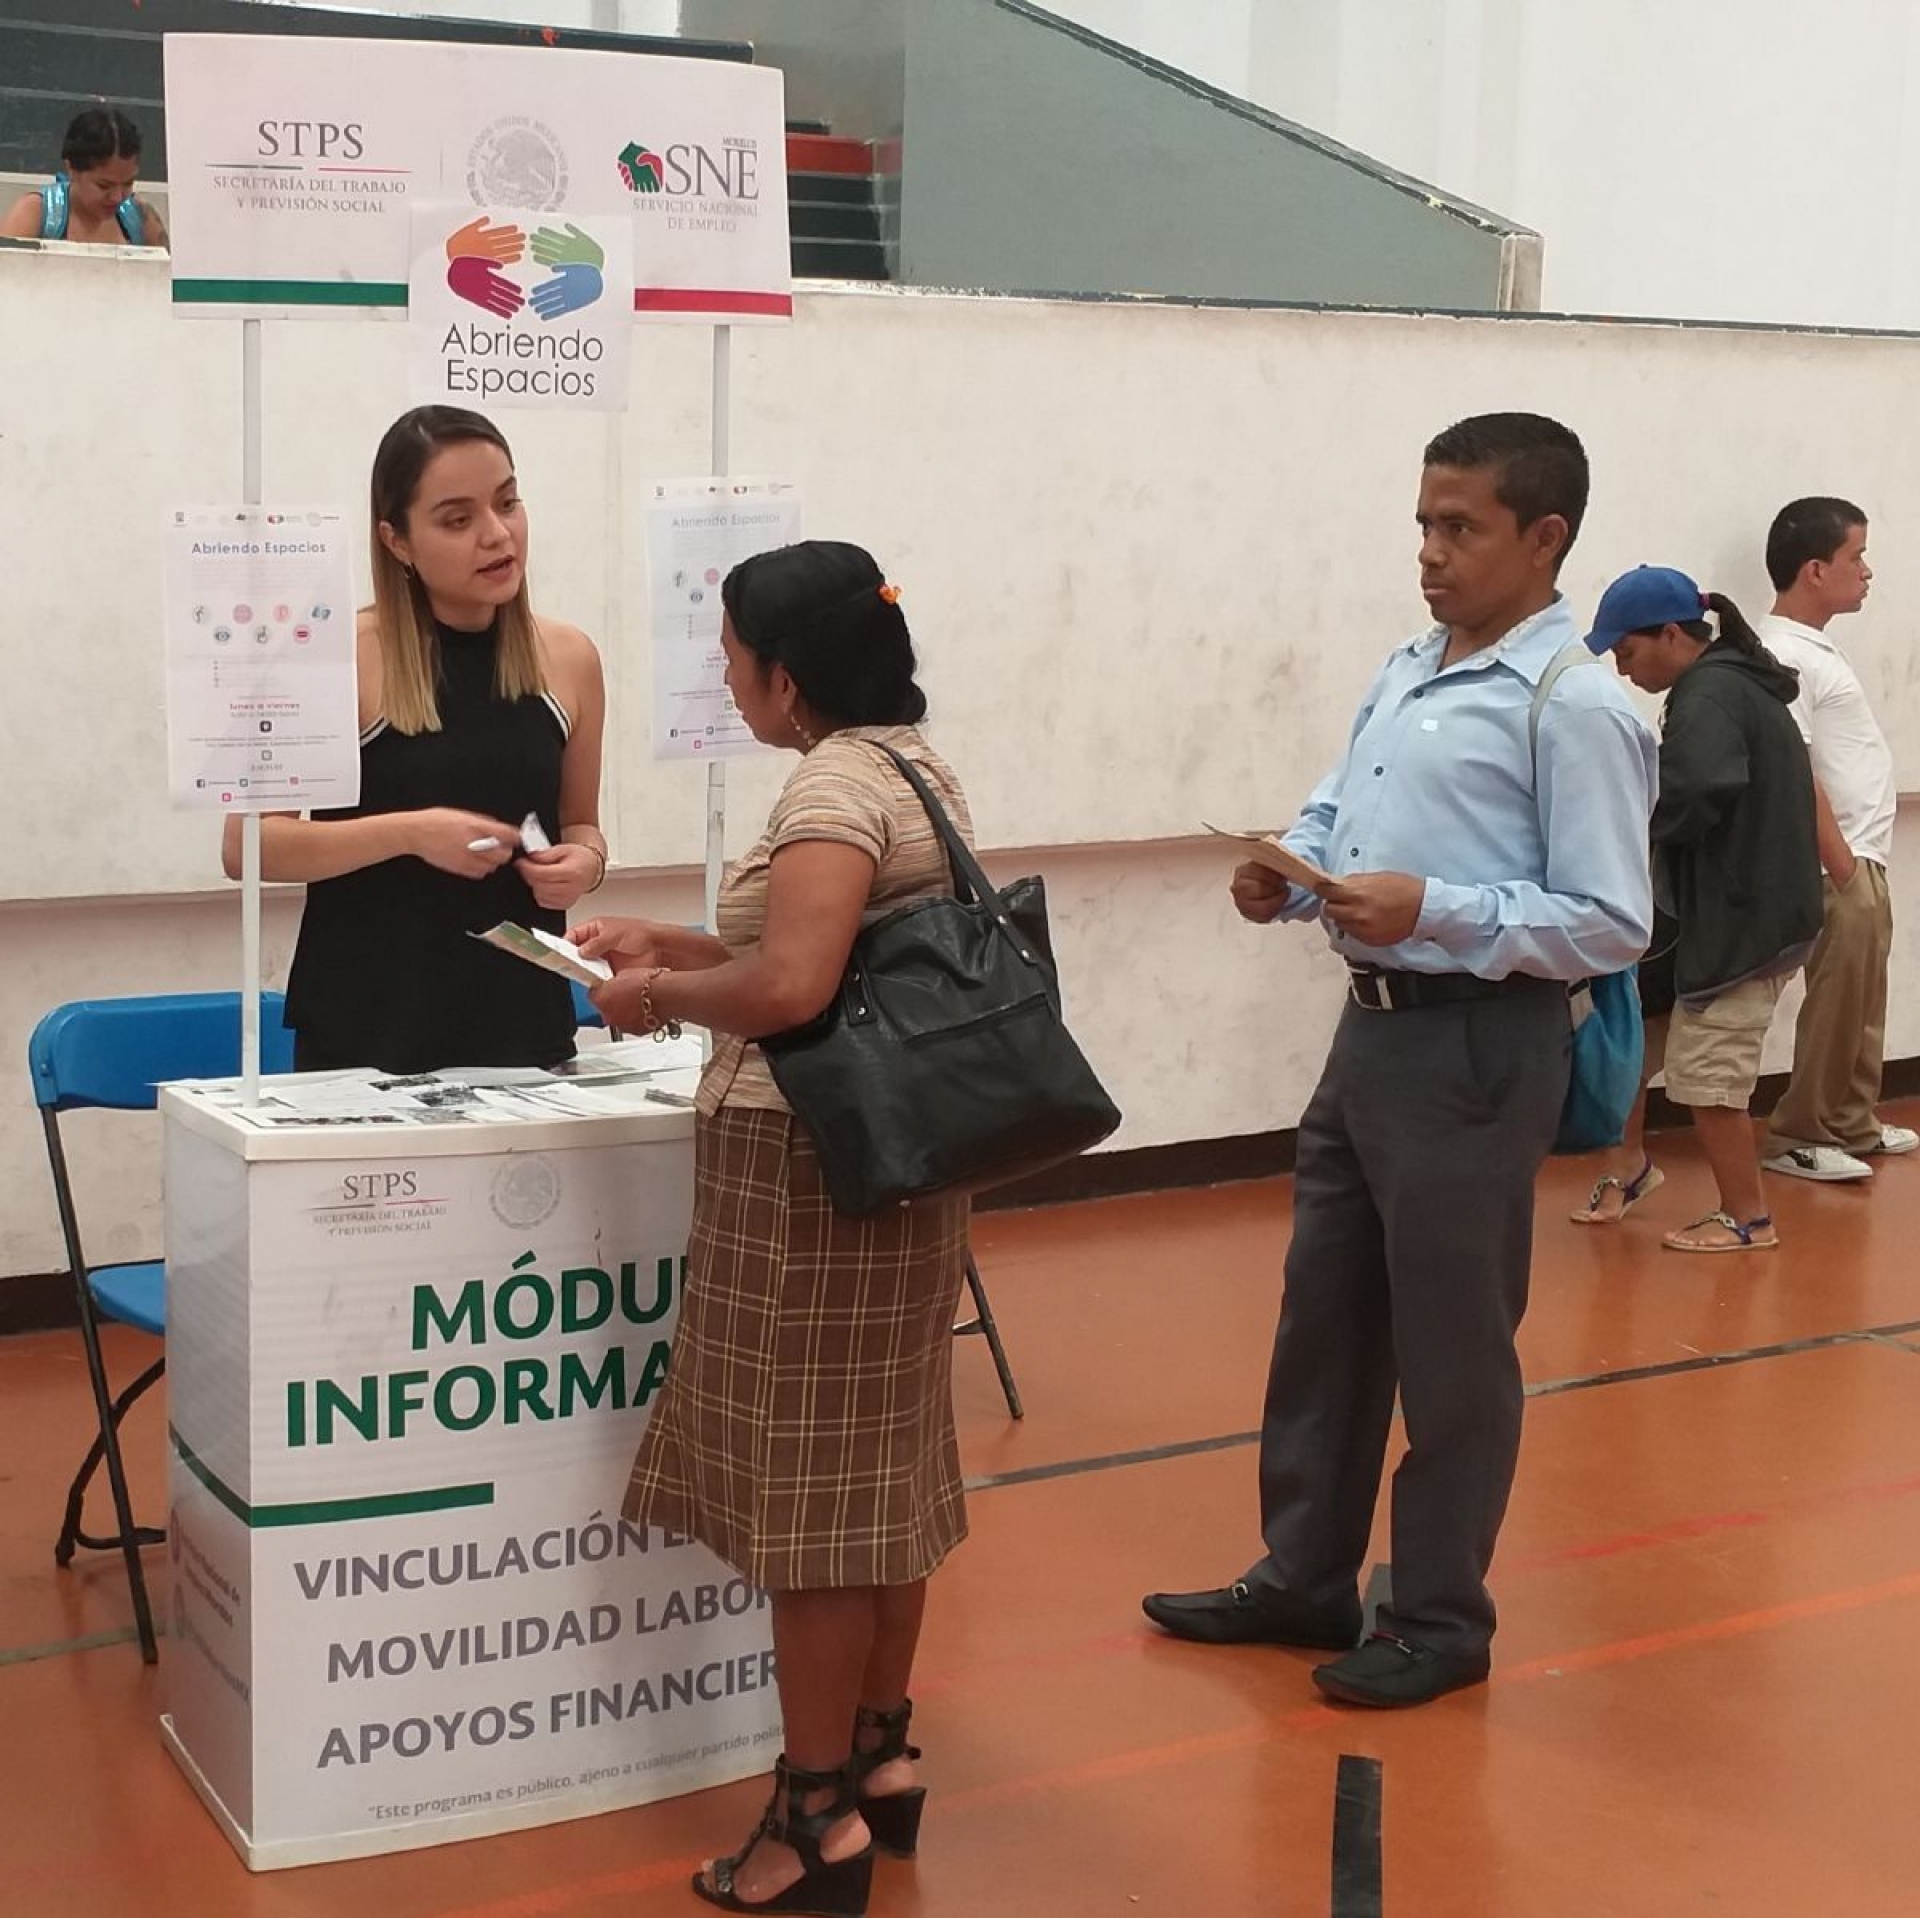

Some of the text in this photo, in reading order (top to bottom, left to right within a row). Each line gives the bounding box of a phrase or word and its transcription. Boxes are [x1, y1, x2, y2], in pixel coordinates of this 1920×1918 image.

[258, 120, 364, 160] STPS
[213, 176, 406, 194] SECRETARÍA DEL TRABAJO
[665, 144, 758, 200] SNE
[250, 196, 329, 212] PREVISIÓN
[332, 200, 384, 213] SOCIAL
[633, 199, 757, 217] SERVICIO NACIONAL
[668, 217, 737, 232] DE EMPLEO
[441, 322, 603, 361] Abriendo
[447, 359, 595, 400] Espacios
[192, 541, 326, 556] Abriendo Espacios
[343, 1170, 418, 1200] STPS
[411, 1250, 688, 1351] MÓDU
[293, 1510, 649, 1600] VINCULACIÓN
[327, 1603, 621, 1683] MOVILIDAD
[316, 1701, 535, 1769] APOYOS
[414, 1791, 492, 1816] programa
[496, 1787, 513, 1799] es
[579, 1764, 620, 1785] ajeno
[623, 1764, 632, 1775] a
[635, 1748, 699, 1771] cualquier
[702, 1732, 751, 1759] partido
